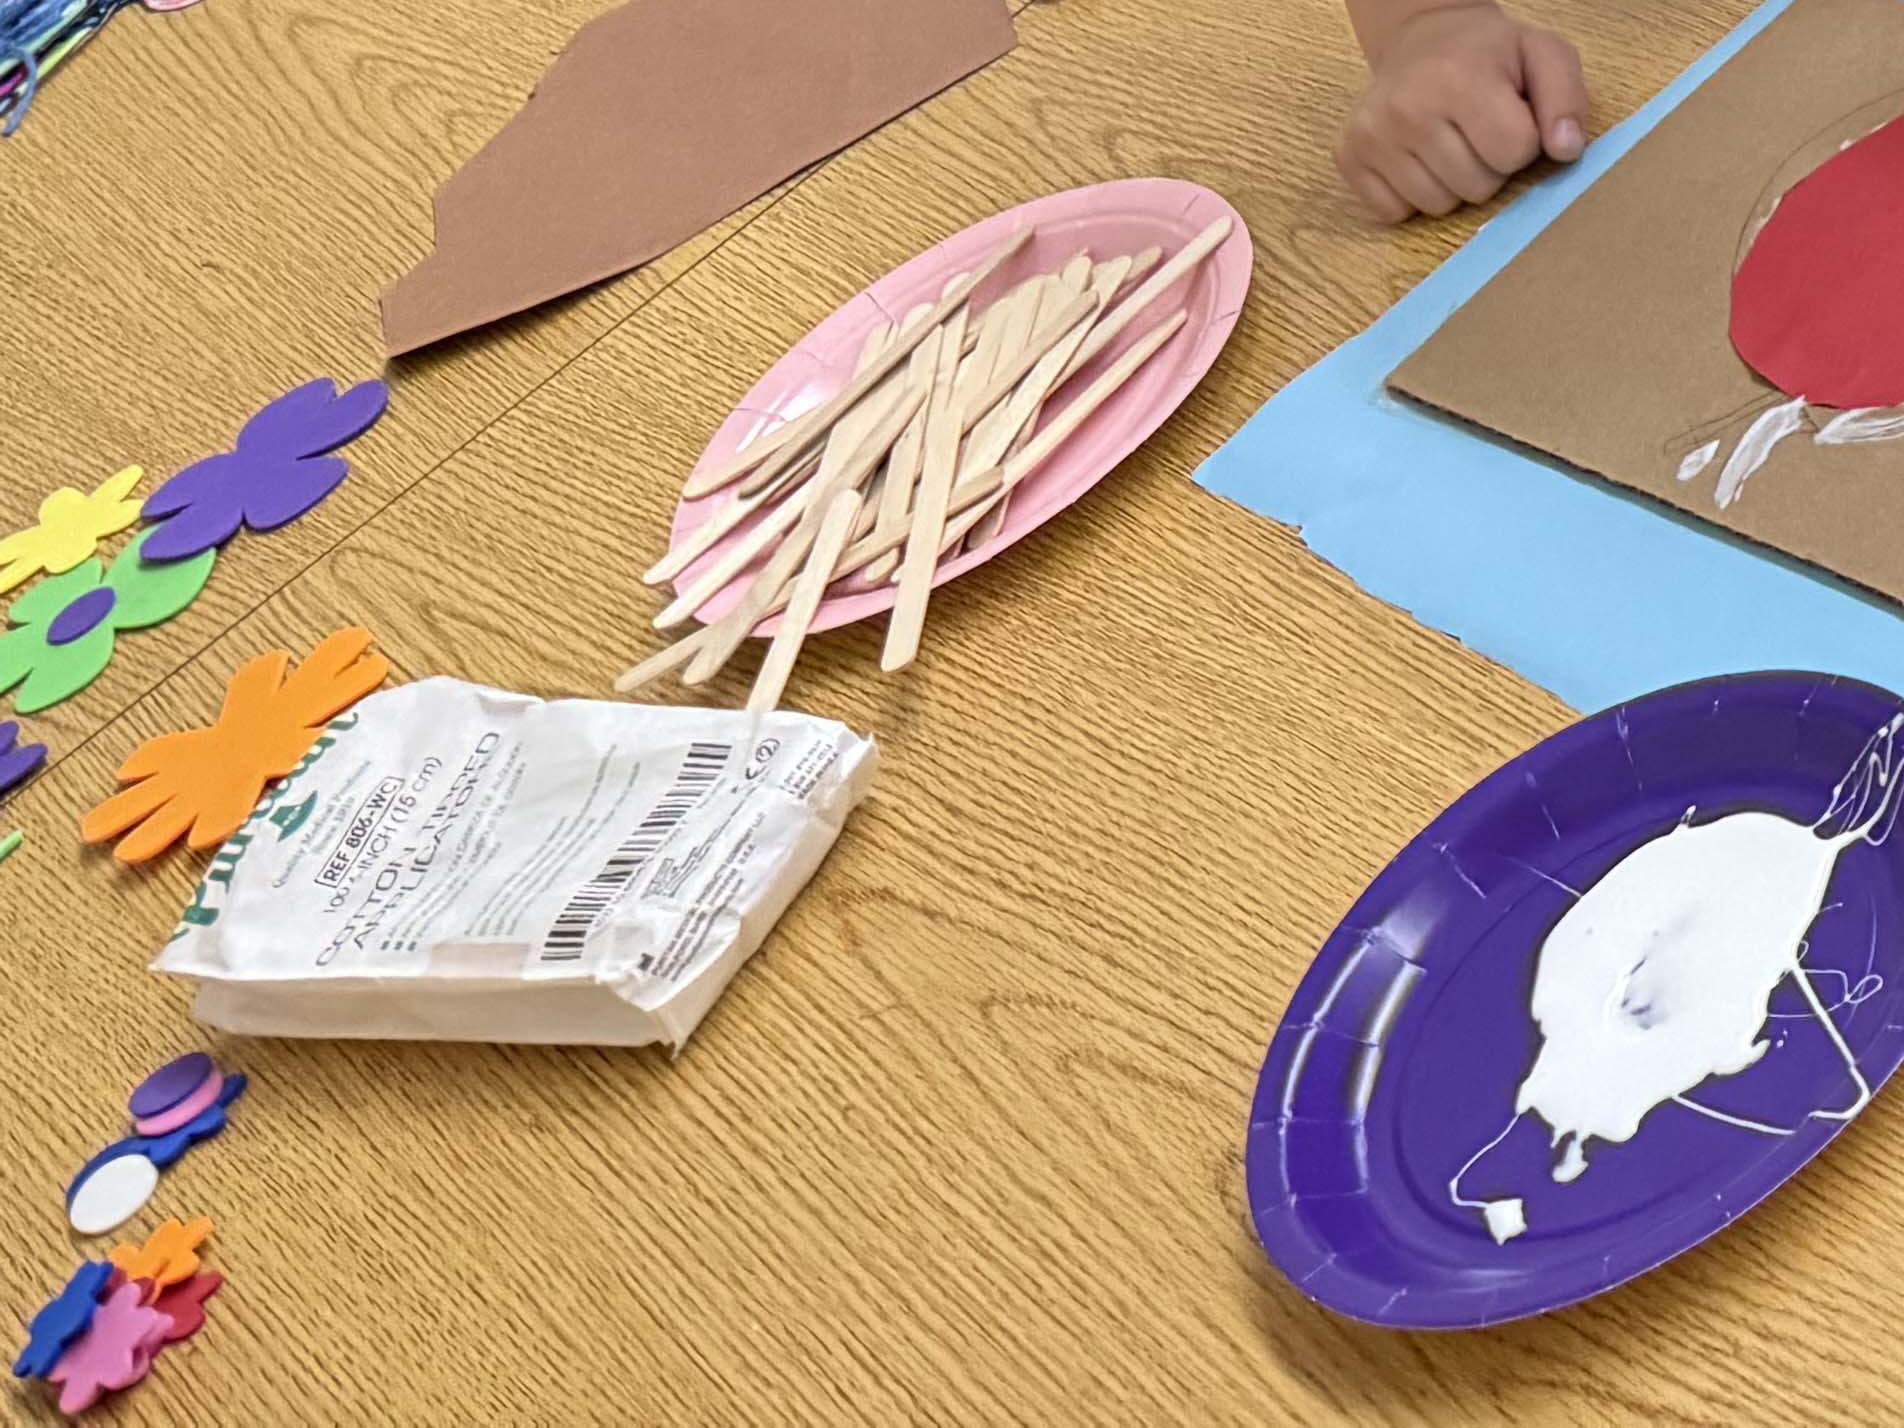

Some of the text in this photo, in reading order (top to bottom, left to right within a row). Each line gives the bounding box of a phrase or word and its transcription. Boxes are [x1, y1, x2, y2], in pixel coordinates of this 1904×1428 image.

[322, 781, 398, 883] REF 806-WC
[323, 886, 351, 914] 100
[411, 756, 443, 792] cm)
[315, 845, 417, 966] COTTON
